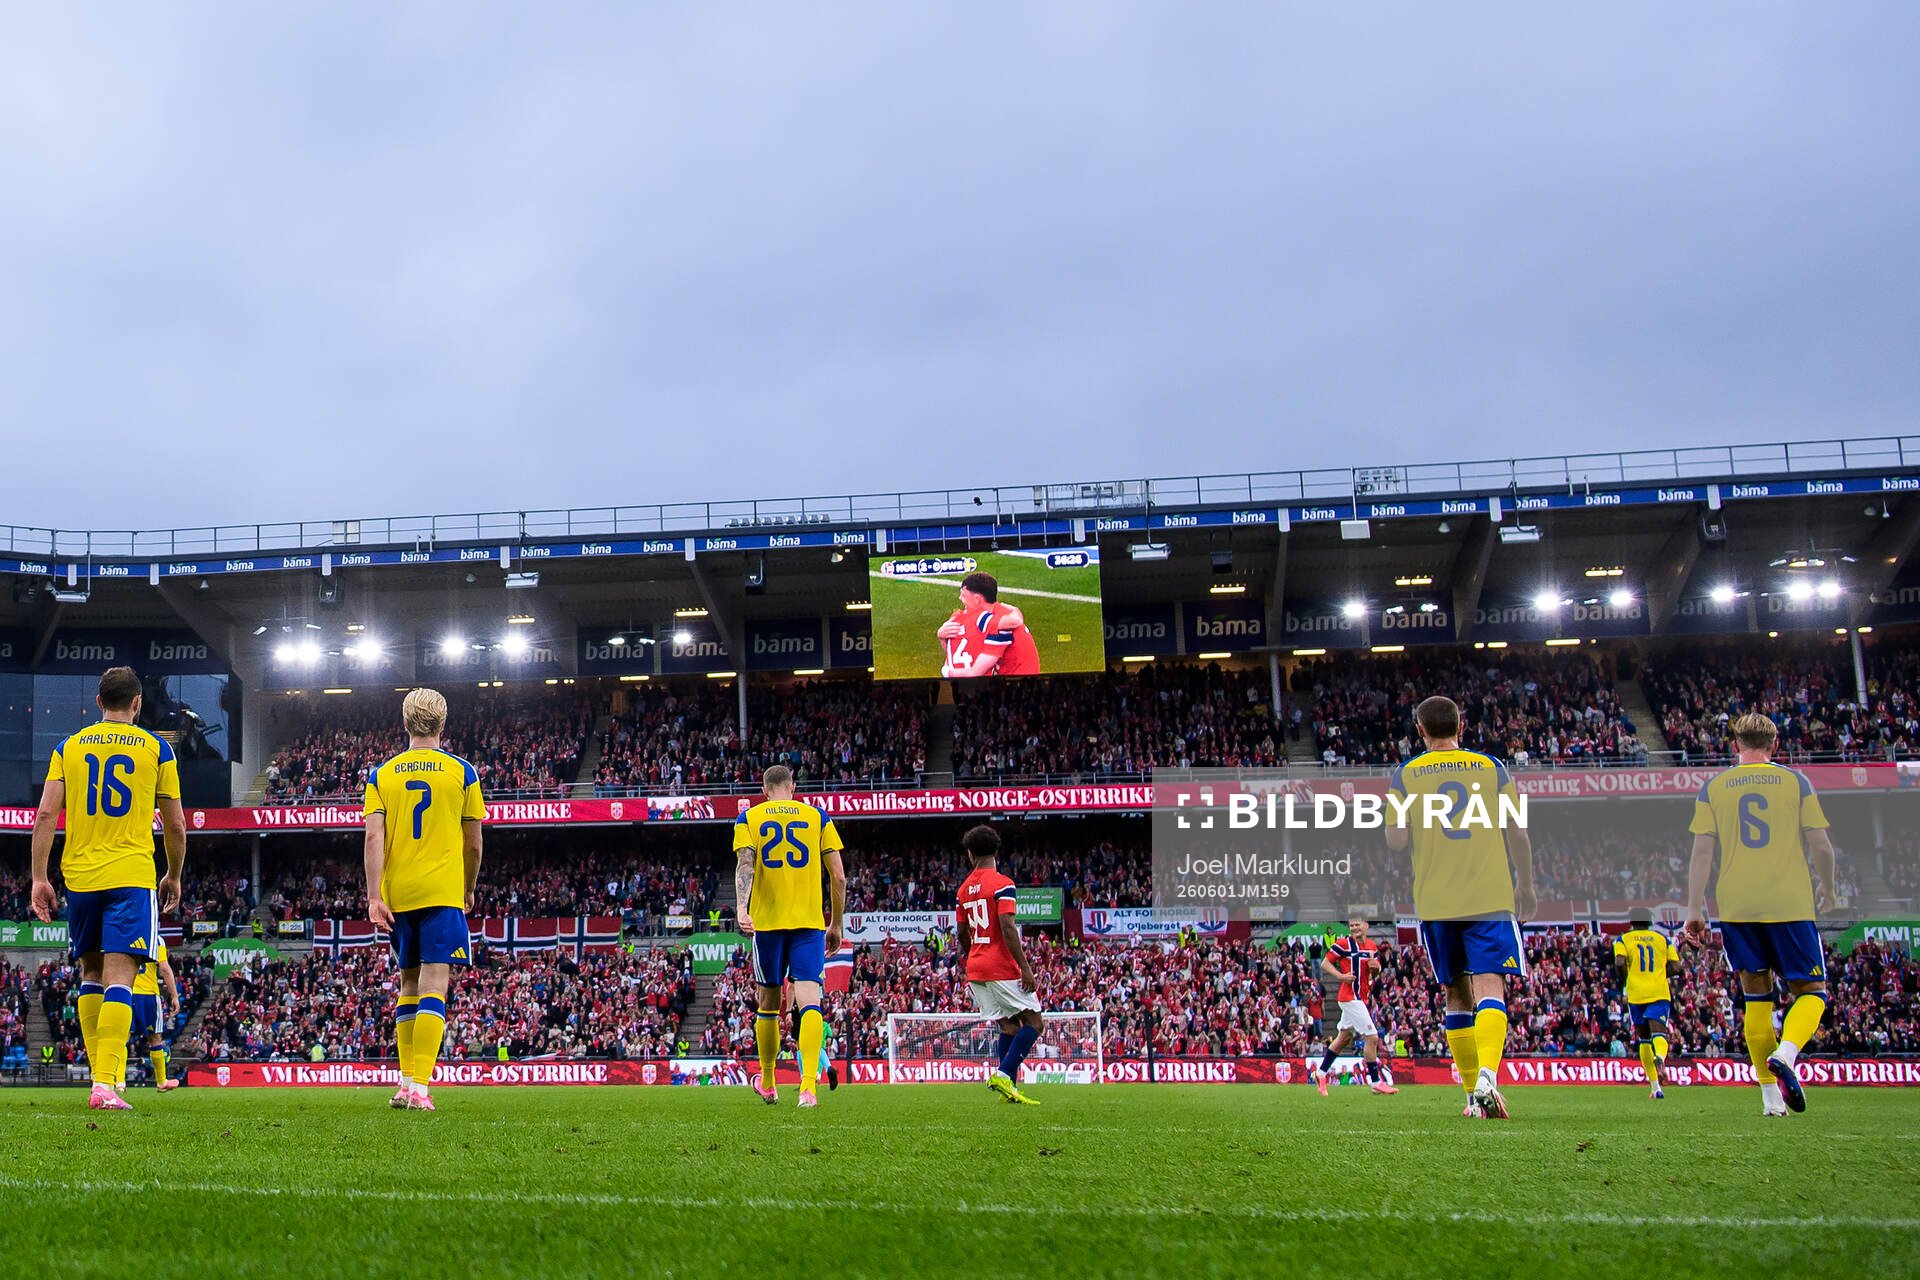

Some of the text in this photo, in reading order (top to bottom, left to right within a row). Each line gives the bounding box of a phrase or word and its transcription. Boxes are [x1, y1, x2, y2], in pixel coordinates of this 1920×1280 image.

[1807, 481, 1843, 493] bama
[1882, 478, 1919, 489] bama
[1658, 489, 1694, 501] bama
[1733, 485, 1769, 497] bama
[1371, 504, 1405, 516] bama
[1442, 501, 1476, 513] bama
[1233, 511, 1266, 523] bama
[1302, 508, 1336, 520] bama
[1097, 518, 1129, 530] bama
[1165, 515, 1197, 526] bama
[706, 538, 737, 549] bama
[770, 535, 800, 547] bama
[834, 532, 865, 544] bama
[521, 547, 550, 557] bama
[582, 544, 612, 555] bama
[643, 541, 674, 552] bama
[342, 553, 371, 565] bama
[461, 549, 490, 559] bama
[20, 562, 47, 573] bama
[226, 560, 254, 571] bama
[283, 556, 312, 568] bama
[100, 565, 129, 576] bama
[169, 563, 197, 575] bama
[1286, 612, 1350, 632] bama
[1382, 609, 1447, 630] bama
[1197, 616, 1261, 637] bama
[754, 633, 814, 654] bama
[56, 640, 115, 660] bama
[150, 640, 207, 660] bama
[585, 640, 644, 661] bama
[79, 734, 146, 748] KARLSTRÖM
[394, 761, 445, 774] BERGVALL
[1413, 761, 1485, 778] LAGERBIELKE
[84, 752, 135, 818] 16
[1725, 774, 1782, 789] JOHANSSON
[839, 792, 955, 812] Kvalifisering
[959, 786, 1157, 808] NORGE-ØSTERRIKE
[252, 806, 367, 825] VM Kvalifiser
[405, 780, 432, 840] 7
[482, 802, 572, 821] STERRIKE
[765, 806, 800, 815] NILSSON
[1437, 781, 1472, 840] 2
[1738, 792, 1771, 849] 6
[759, 820, 810, 869] 25
[1016, 903, 1041, 914] KIWI
[1113, 908, 1197, 918] ALT FOR NORGE
[883, 915, 901, 923] FOR
[33, 927, 66, 942] KIWI
[1863, 926, 1910, 942] KIWI
[689, 943, 726, 961] KIWI
[1637, 943, 1655, 973] 11
[261, 1066, 294, 1083] VM
[429, 1064, 608, 1083] ORGE-ØSTERRIKE
[851, 1063, 884, 1081] VM
[1505, 1062, 1545, 1081] VM
